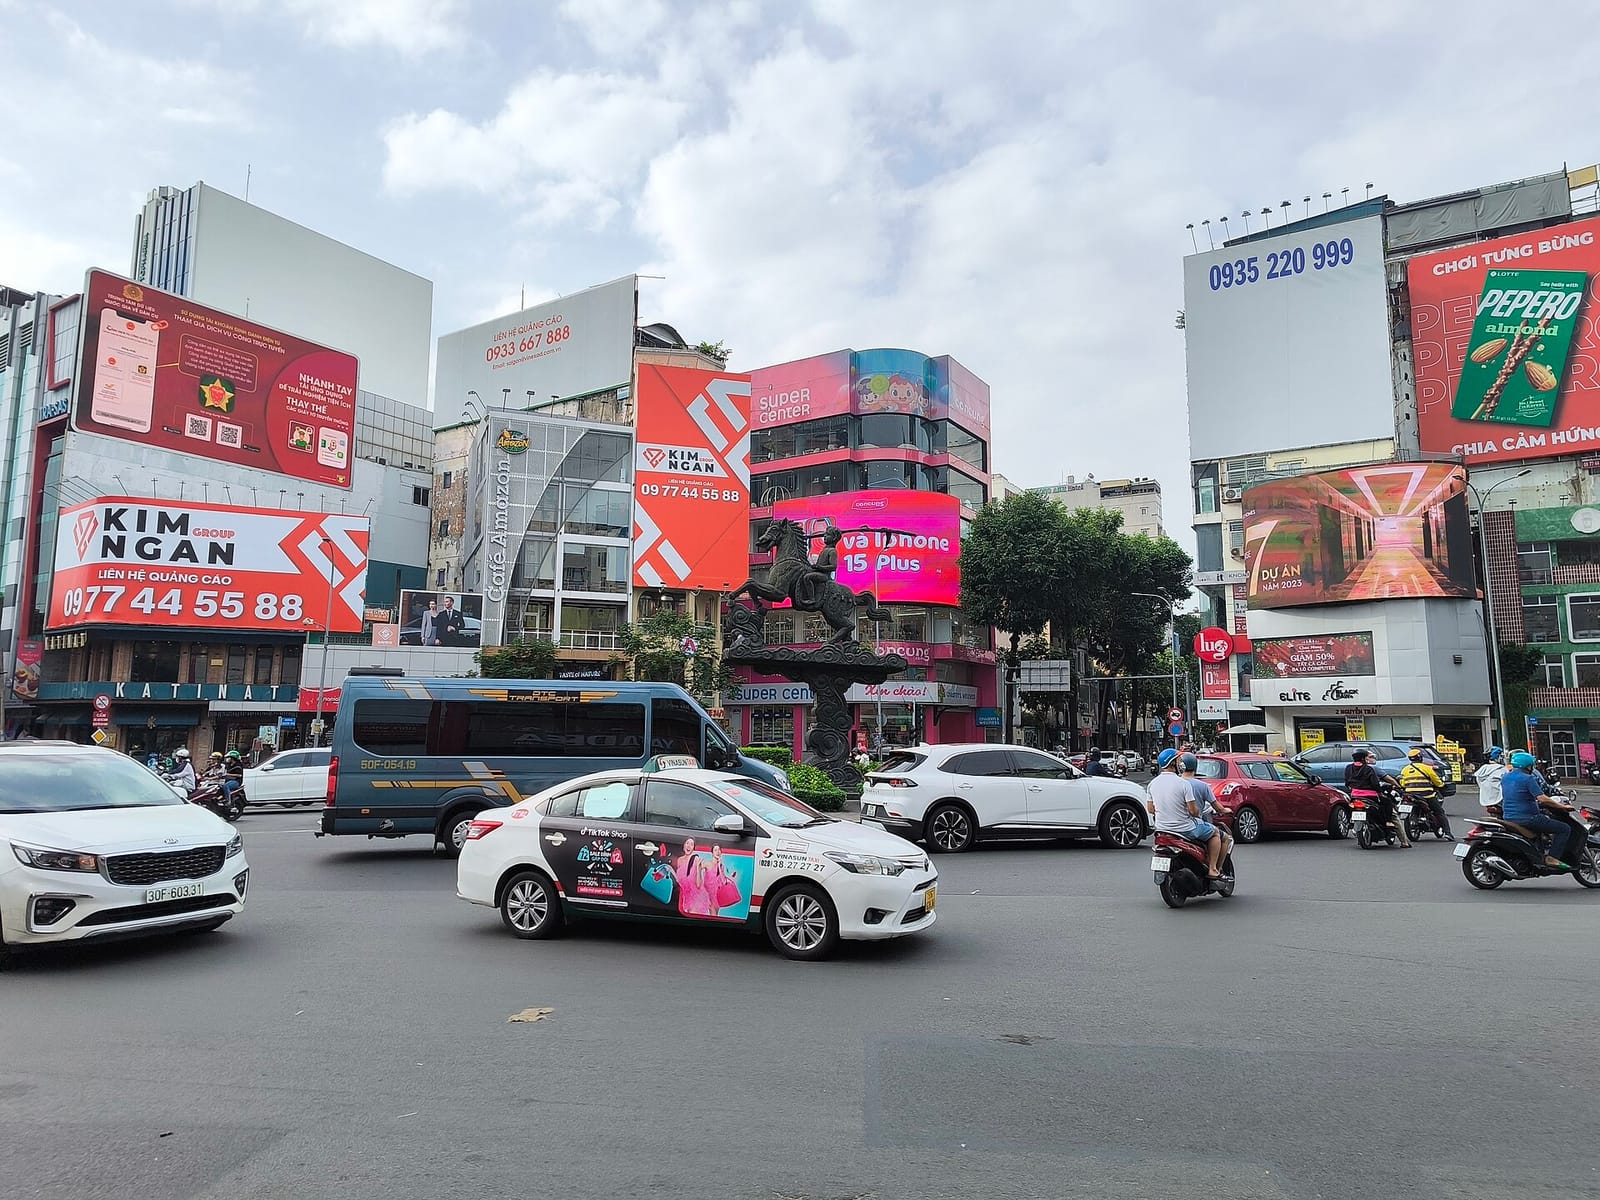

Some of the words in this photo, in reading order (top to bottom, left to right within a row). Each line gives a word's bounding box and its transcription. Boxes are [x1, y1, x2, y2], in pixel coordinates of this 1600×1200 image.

[1432, 255, 1478, 276] CHƠI
[1482, 243, 1534, 267] TƯNG
[1538, 231, 1594, 255] BỪNG
[1209, 256, 1260, 291] 0935
[1266, 247, 1306, 280] 220
[1312, 237, 1354, 270] 999
[1476, 289, 1582, 320] PEPERO
[174, 313, 193, 325] THAM
[193, 320, 206, 330] GIA
[1485, 322, 1559, 337] almond
[486, 341, 516, 362] 0933
[519, 333, 543, 353] 667
[546, 325, 570, 345] 888
[299, 372, 334, 391] NHANH
[336, 384, 353, 396] TAY
[286, 395, 310, 409] THAY
[310, 403, 328, 415] THẾ
[1451, 440, 1498, 457] CHIA
[1502, 431, 1548, 451] CẢM
[668, 449, 699, 461] KIM
[668, 460, 715, 473] NGAN
[490, 459, 511, 549] Amazon
[701, 488, 720, 500] 55
[722, 489, 740, 502] 88
[103, 506, 191, 536] KIM
[192, 526, 235, 540] GROUP
[843, 532, 869, 551] và
[100, 535, 235, 566] NGAN
[1245, 519, 1279, 597] 7
[843, 553, 868, 573] 15
[876, 554, 920, 572] Plus
[1261, 566, 1279, 582] DỰ
[1281, 563, 1301, 578] ÁN
[98, 568, 126, 582] LIÊN
[127, 568, 146, 583] HỆ
[148, 568, 199, 585] QUẢNG
[200, 571, 233, 586] CÁO
[487, 554, 507, 602] Café
[1281, 578, 1303, 590] 2023
[193, 590, 245, 619] 55
[254, 592, 304, 622] 88
[874, 646, 931, 662] oncung
[1200, 633, 1229, 660] lug
[1315, 652, 1335, 661] 50%
[115, 682, 279, 700] KATINAT
[892, 683, 928, 697] chào!
[360, 759, 417, 770] 50F-054.19
[588, 828, 610, 838] TikTok
[611, 830, 628, 839] Shop
[148, 883, 201, 902] 30F-603.31
